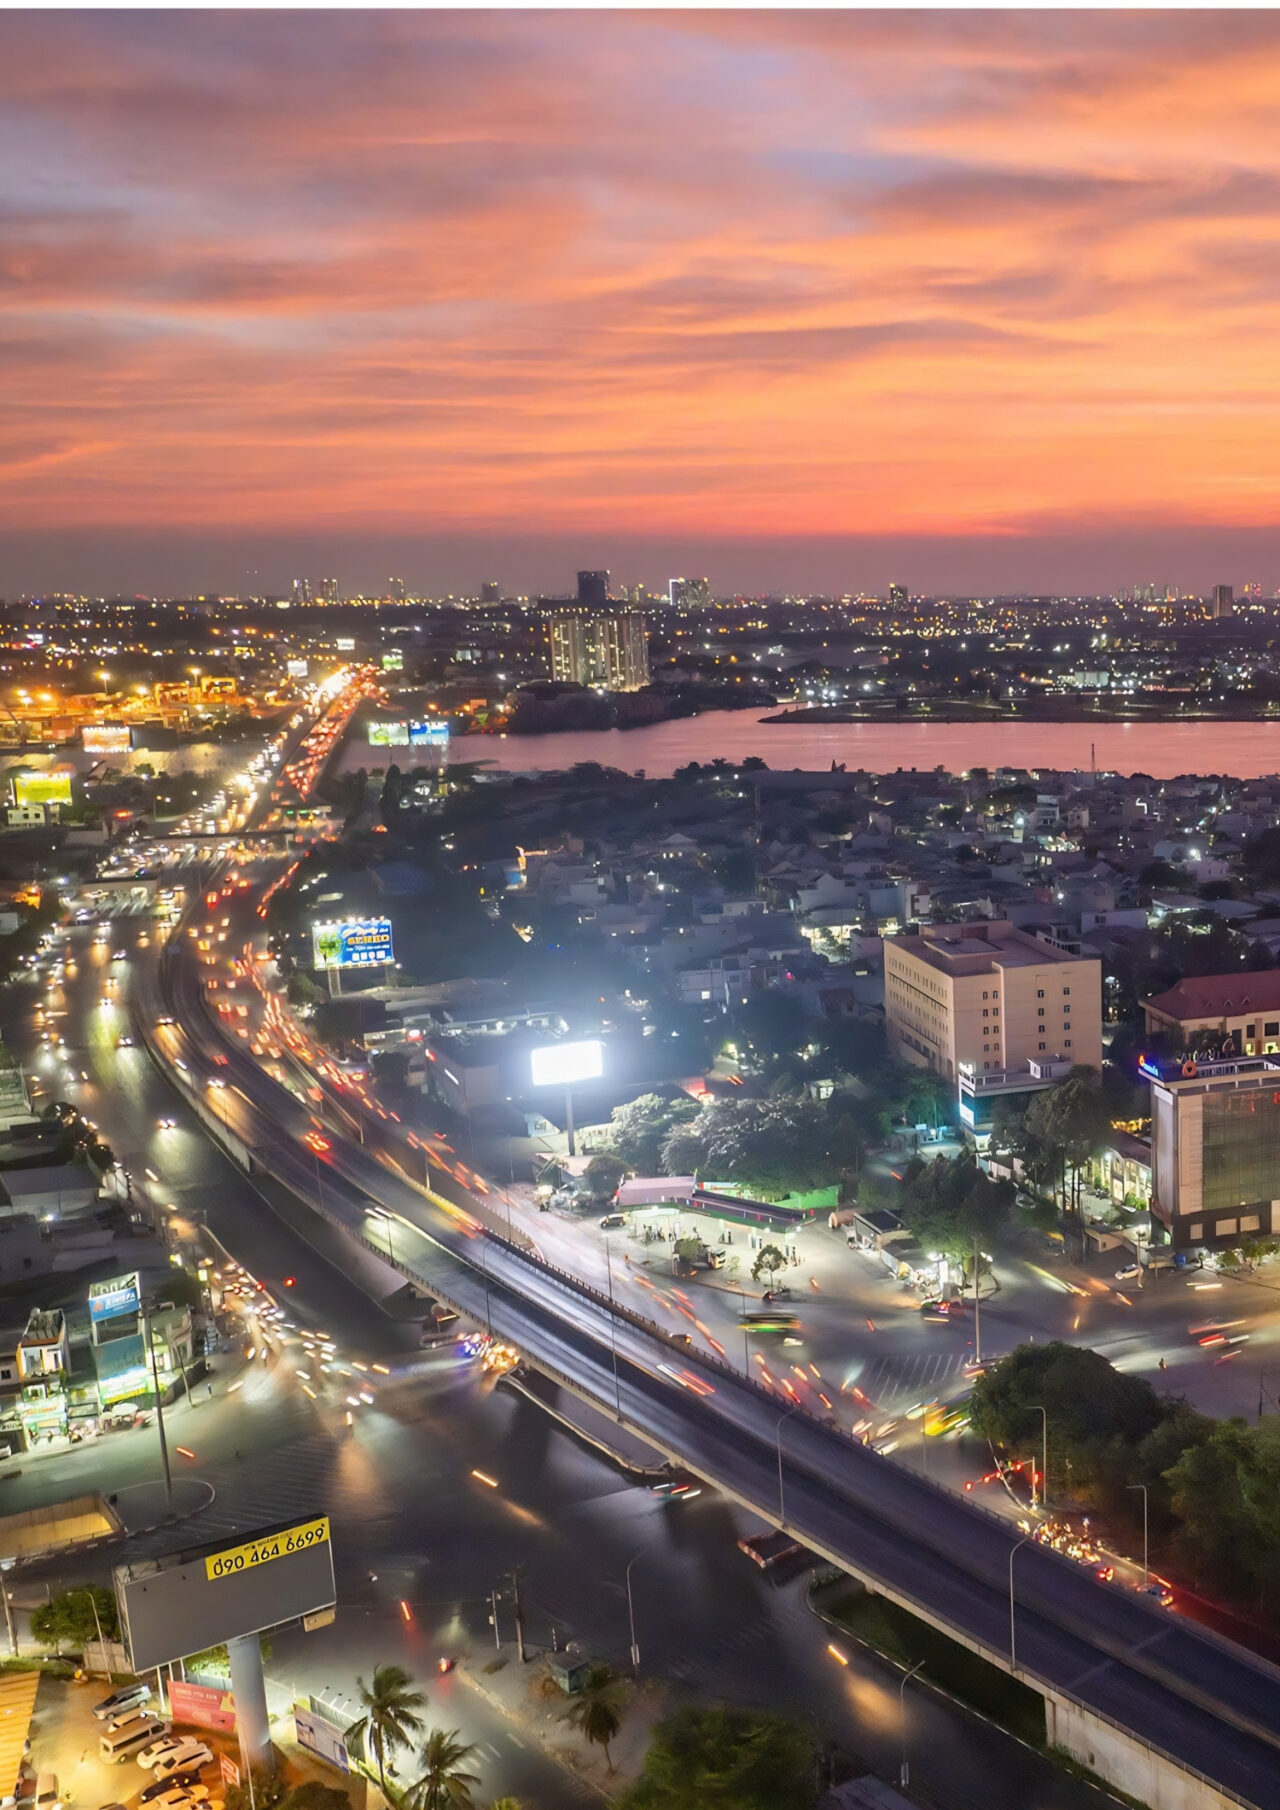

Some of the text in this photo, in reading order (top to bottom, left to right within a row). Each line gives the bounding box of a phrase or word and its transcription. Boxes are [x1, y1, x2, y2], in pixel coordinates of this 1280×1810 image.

[213, 1555, 245, 1576] 090
[250, 1543, 280, 1563] 464
[285, 1527, 324, 1552] 6699
